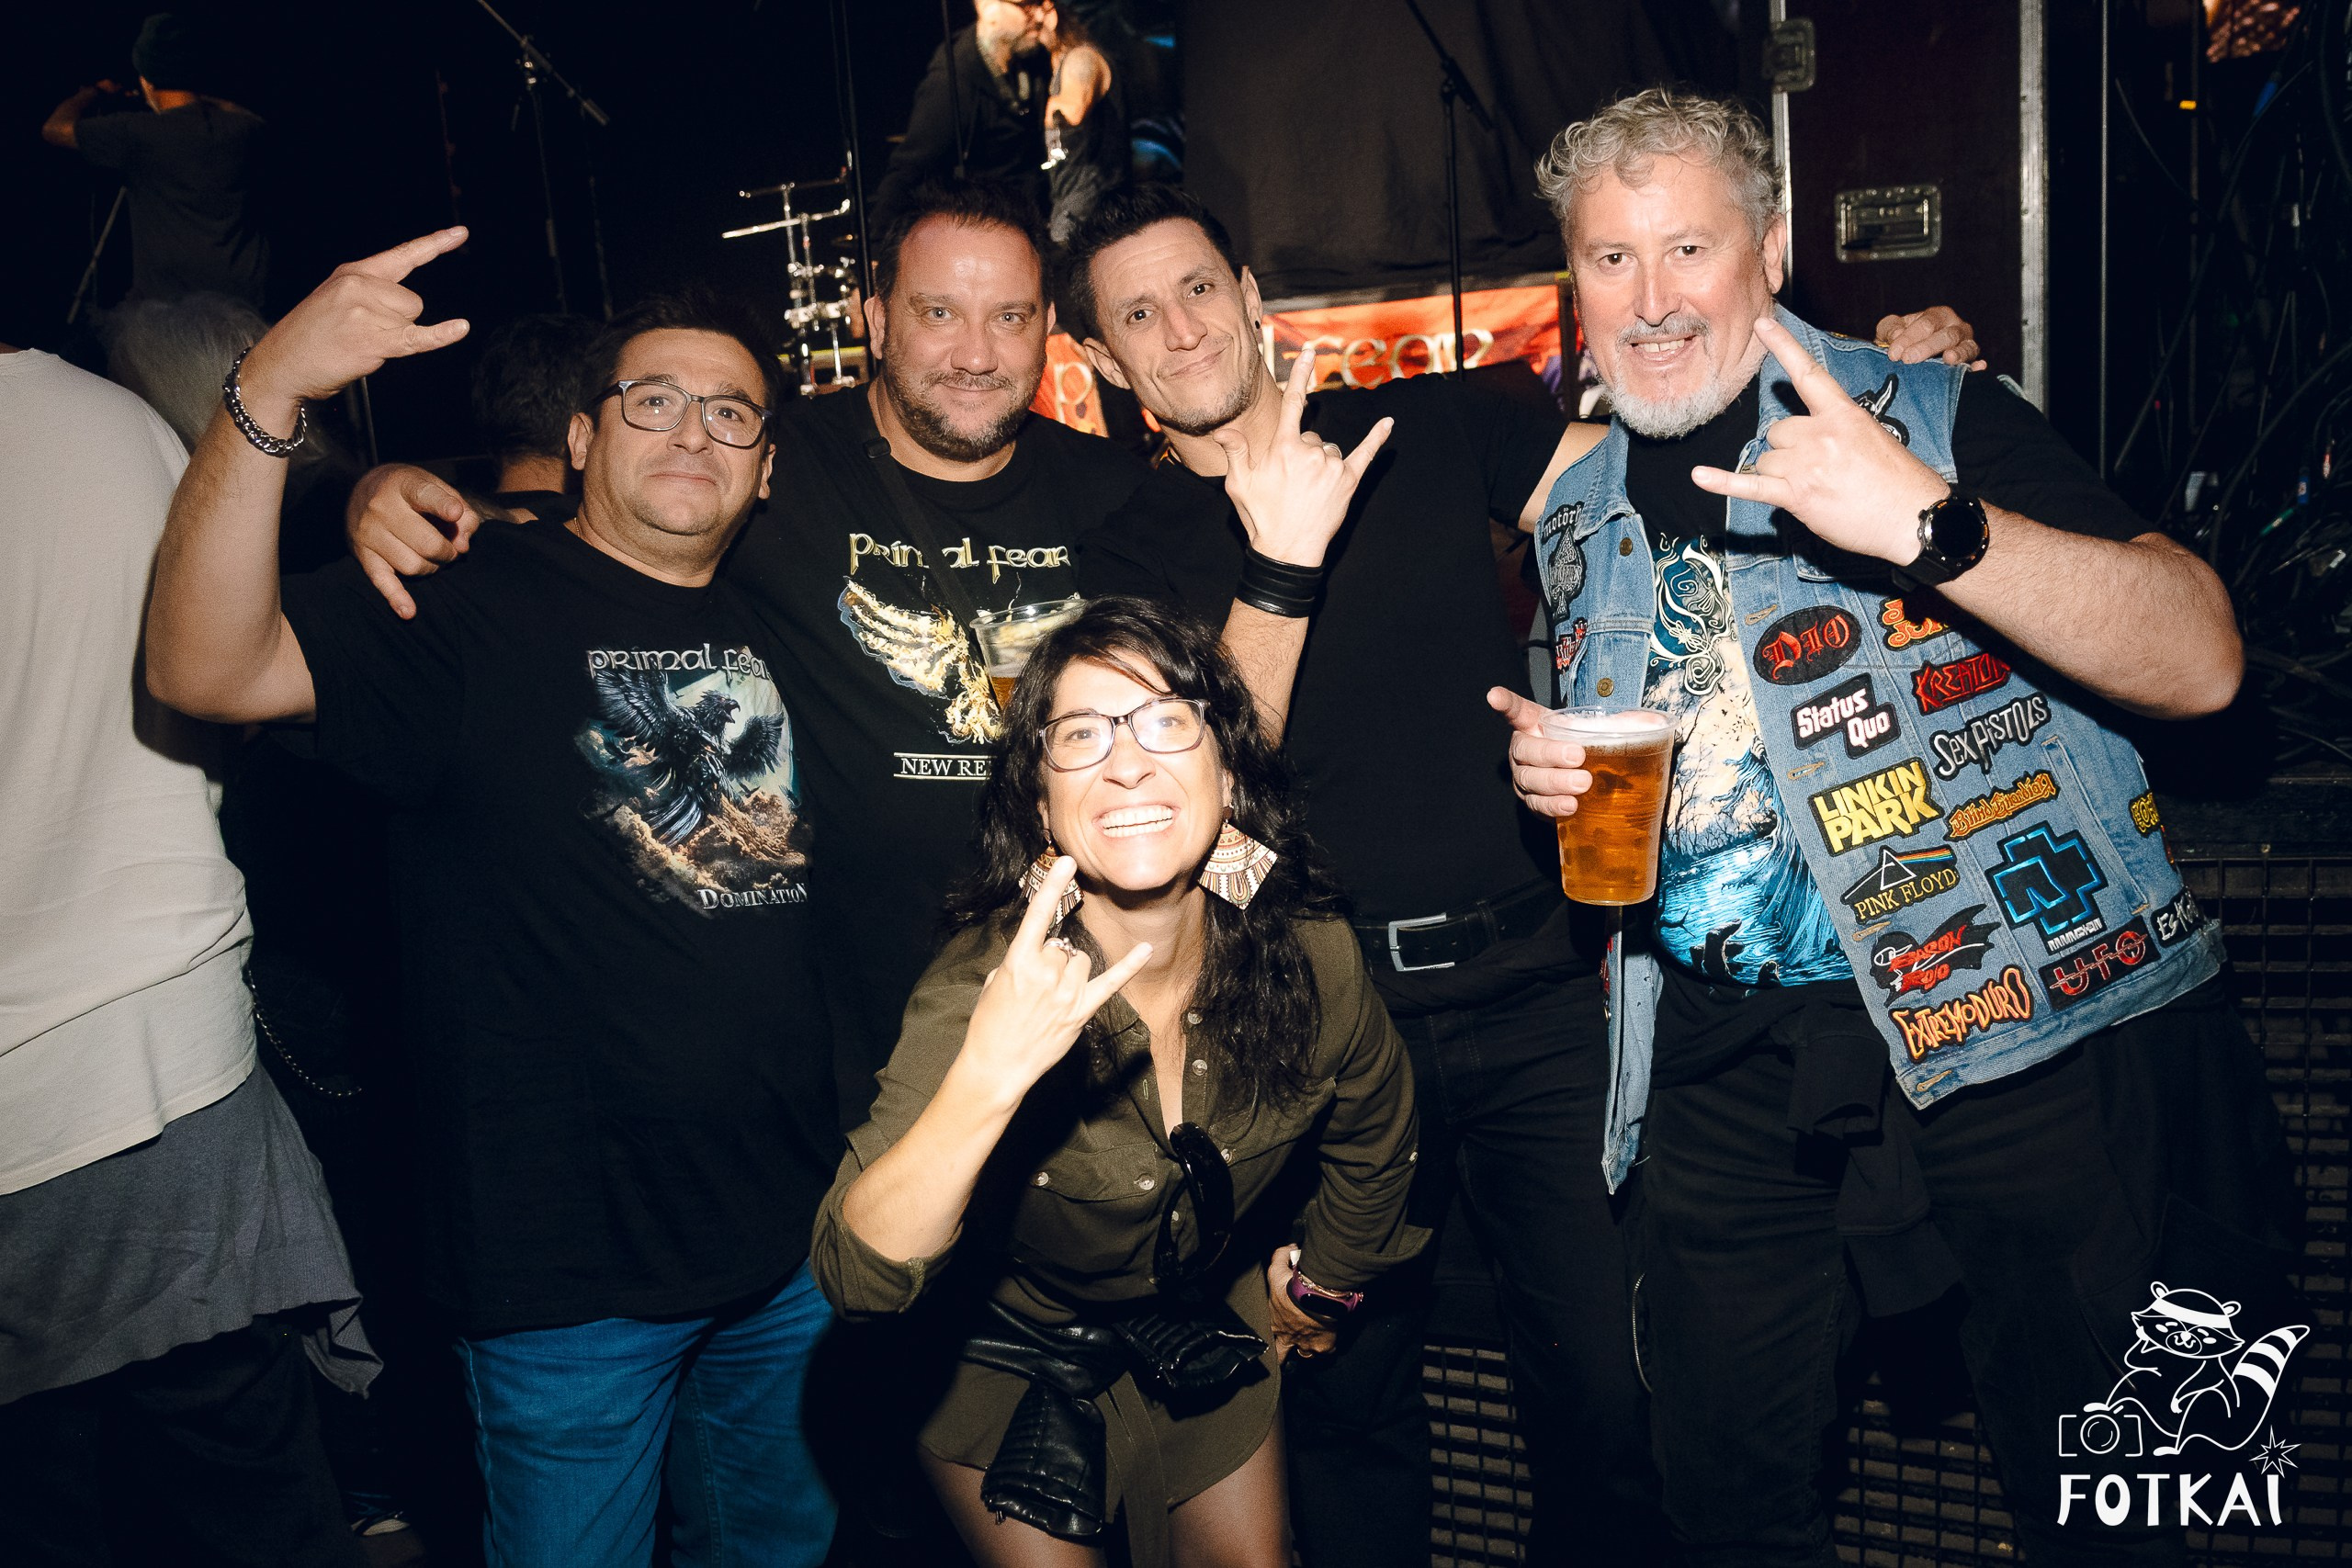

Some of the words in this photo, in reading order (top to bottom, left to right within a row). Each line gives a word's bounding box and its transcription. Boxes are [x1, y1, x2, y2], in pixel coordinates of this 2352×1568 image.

[1762, 614, 1850, 681] DIO
[1796, 688, 1869, 737] Status
[1846, 711, 1891, 750] Quo
[900, 758, 953, 775] NEW
[1814, 761, 1925, 819] LINKIN
[1825, 786, 1939, 852] PARK
[1950, 798, 1993, 838] Blind
[697, 883, 808, 909] DOMINATION
[1854, 889, 1899, 919] PINK
[1899, 868, 1957, 904] FLOYD
[2051, 931, 2146, 996] UFO
